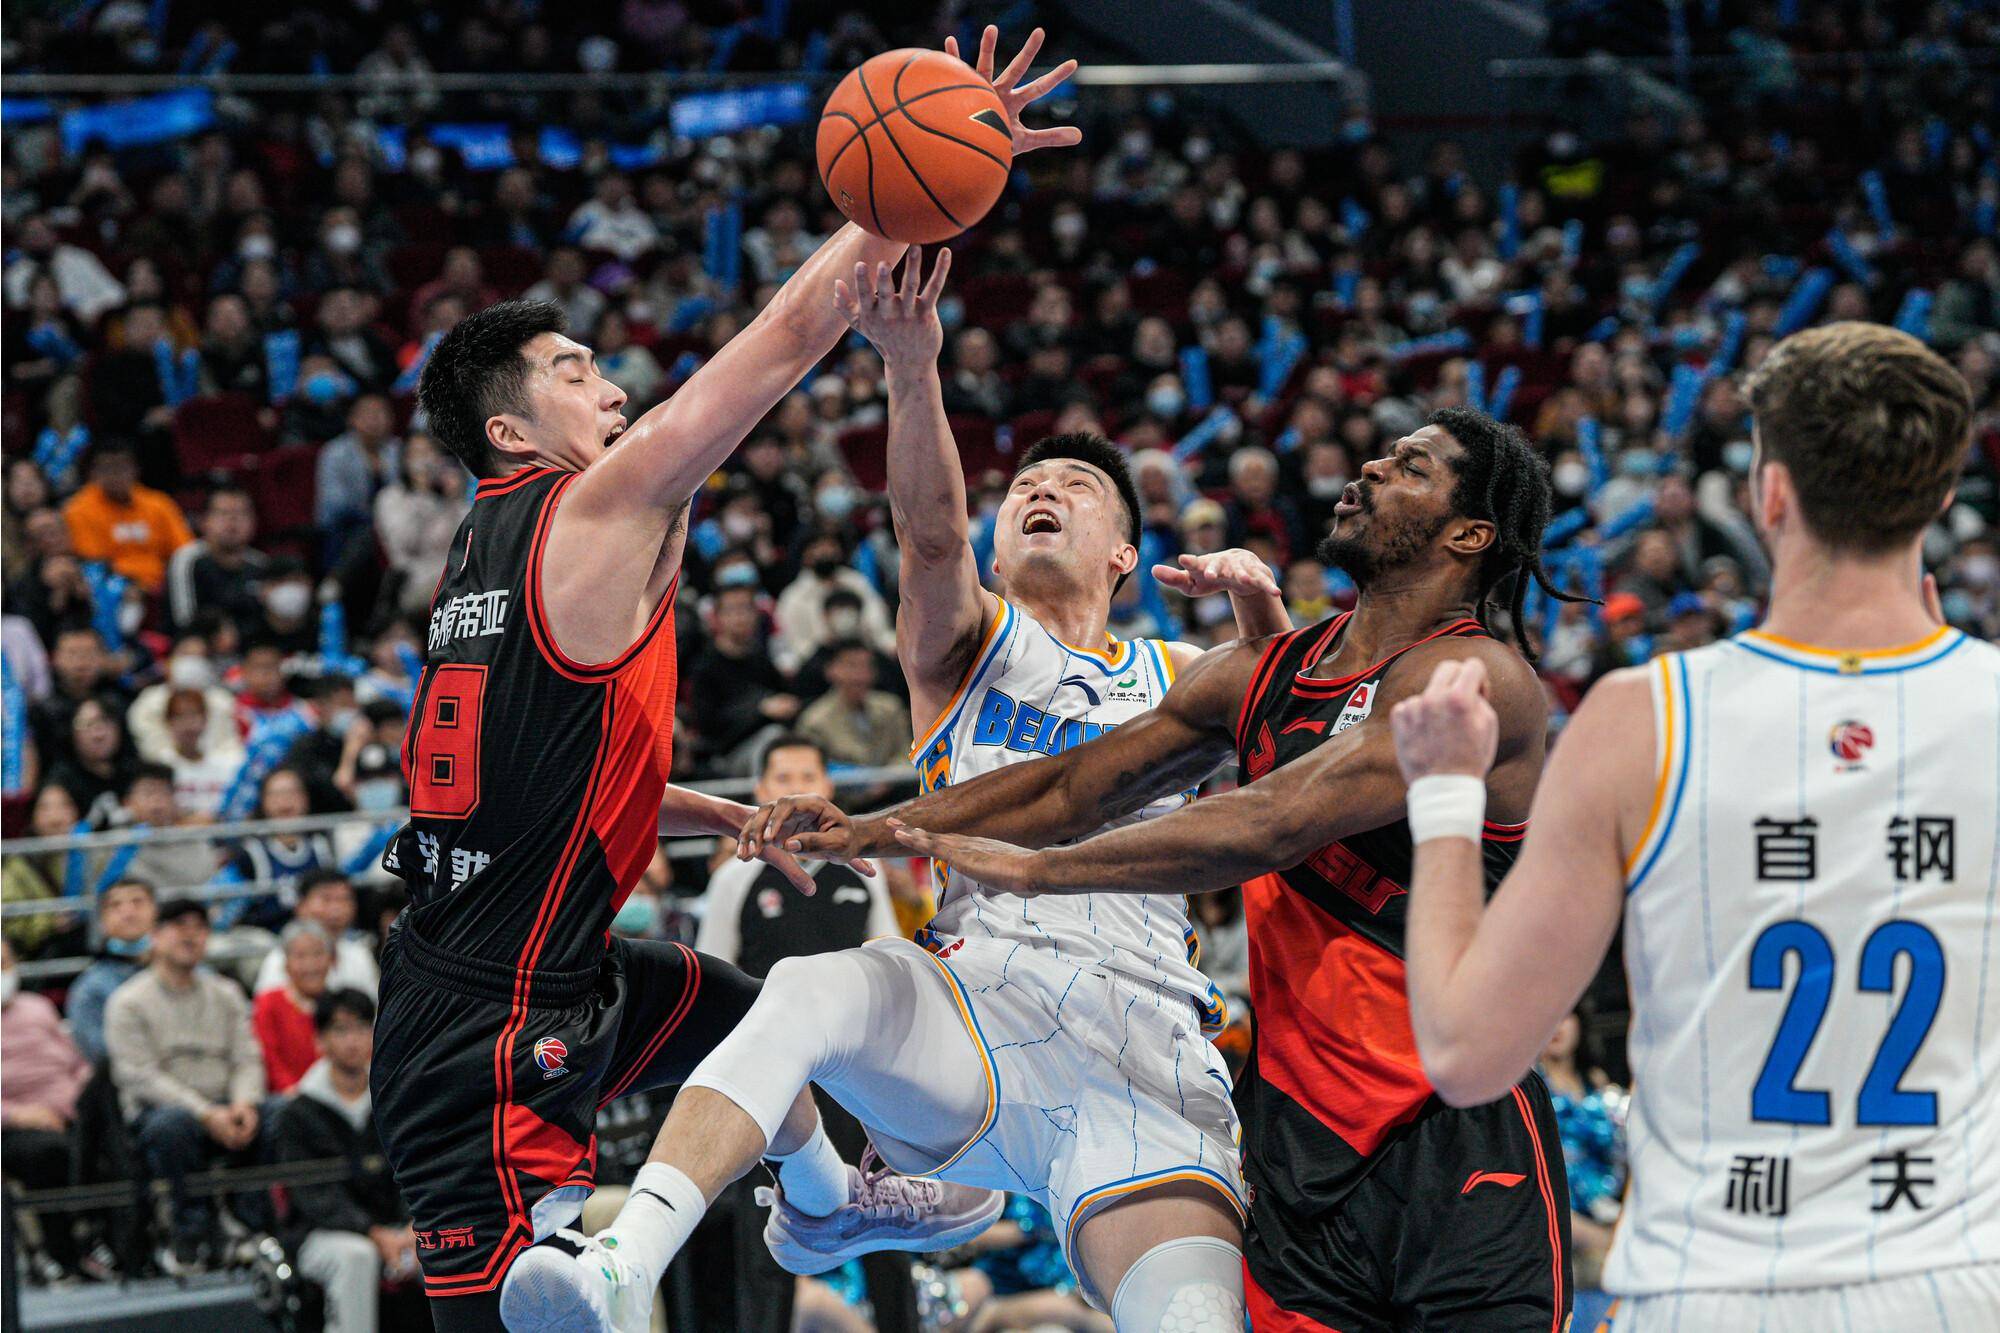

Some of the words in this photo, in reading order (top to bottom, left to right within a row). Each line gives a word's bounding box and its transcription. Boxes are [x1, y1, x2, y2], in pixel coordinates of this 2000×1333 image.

[973, 687, 1120, 757] BEIJI
[1752, 816, 1956, 882] 首钢
[1749, 920, 1946, 1127] 22
[1725, 1150, 1934, 1217] 利夫
